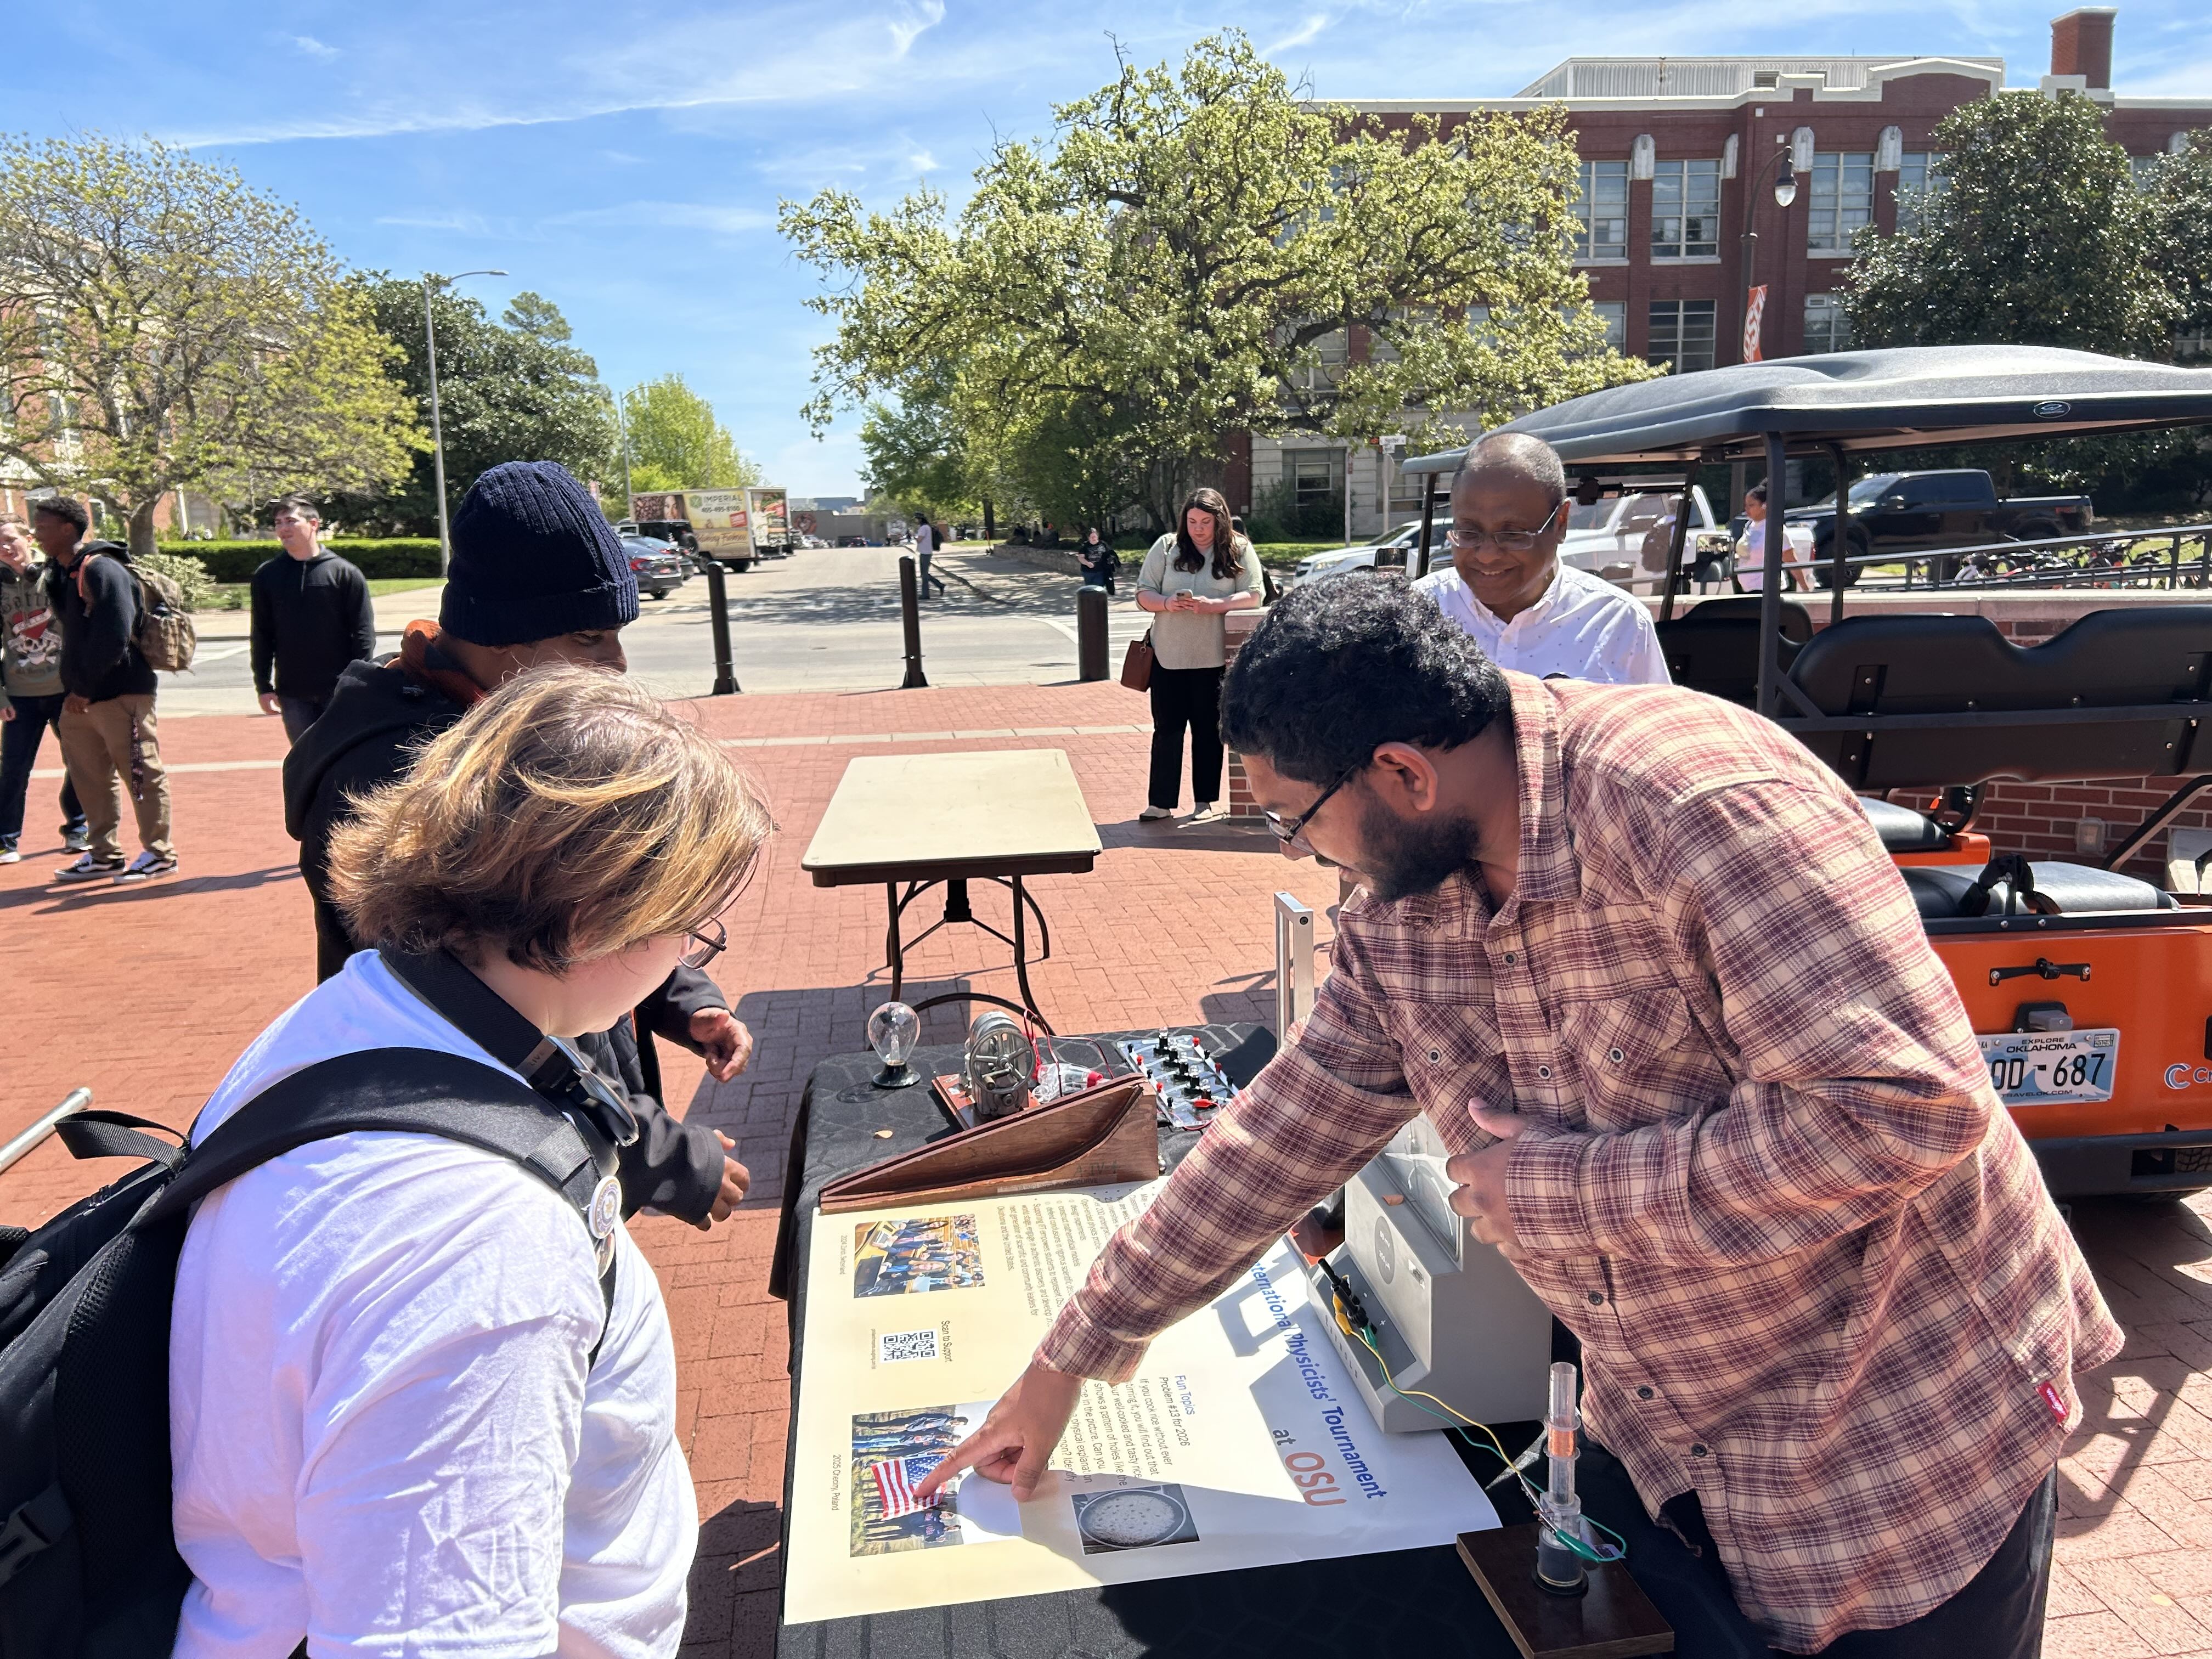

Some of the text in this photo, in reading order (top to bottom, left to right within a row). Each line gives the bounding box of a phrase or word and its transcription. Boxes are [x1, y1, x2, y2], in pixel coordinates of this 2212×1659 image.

[2006, 1042, 2077, 1053] OKLAHOMA
[2021, 1037, 2065, 1045] EXPLORE
[2053, 1053, 2106, 1087] 687
[1033, 1204, 1043, 1224] Supporting
[1070, 1205, 1079, 1217] design
[1009, 1214, 1021, 1234] generation
[1086, 1222, 1097, 1235] physics
[1003, 1242, 1013, 1255] United
[1017, 1240, 1027, 1258] scientific
[1040, 1231, 1050, 1251] empowers
[1063, 1223, 1077, 1250] mathematical
[1070, 1250, 1081, 1266] models
[1050, 1220, 1061, 1243] conclusions
[1056, 1248, 1066, 1265] rigorous
[1061, 1266, 1073, 1284] scientific
[1006, 1255, 1014, 1271] States.
[1020, 1259, 1030, 1267] and
[1045, 1252, 1056, 1271] students
[1022, 1268, 1034, 1291] community
[1025, 1227, 1035, 1242] engage
[1035, 1268, 1045, 1288] discovery,
[1042, 1298, 1052, 1316] develop
[1050, 1277, 1062, 1297] represent
[1027, 1292, 1037, 1308] leaders
[941, 1321, 950, 1335] Scan
[942, 1342, 953, 1362] Support
[1251, 1262, 1295, 1331] ternational
[1284, 1334, 1337, 1402] Physicists'
[1322, 1406, 1387, 1499] Tournament
[1094, 1383, 1106, 1404] shows
[1139, 1385, 1150, 1396] you
[1175, 1375, 1196, 1415] Fun Topics
[1084, 1407, 1094, 1417] the
[1144, 1398, 1157, 1413] cook
[1159, 1377, 1190, 1446] Problem #13 for 2026
[1099, 1411, 1113, 1433] pattern
[1130, 1411, 1143, 1422] you
[1149, 1414, 1160, 1425] rice
[1070, 1419, 1086, 1443] physical
[1085, 1419, 1098, 1442] picture.
[1111, 1386, 1143, 1479] our well-cooked and tasty rice
[1136, 1423, 1149, 1434] will
[1153, 1426, 1169, 1449] without
[1093, 1443, 1103, 1455] Can
[1140, 1435, 1153, 1447] find
[1108, 1442, 1121, 1460] holes
[1144, 1449, 1155, 1460] out
[1161, 1451, 1172, 1465] ever
[833, 1454, 842, 1469] 2025
[1063, 1458, 1077, 1482] Identify
[1076, 1445, 1092, 1483] explanation
[1093, 1457, 1105, 1469] you
[1114, 1462, 1125, 1473] like
[1147, 1460, 1160, 1475] that
[1272, 1430, 1347, 1507] at OSU
[1118, 1475, 1128, 1486] the
[831, 1492, 840, 1511] Poland
